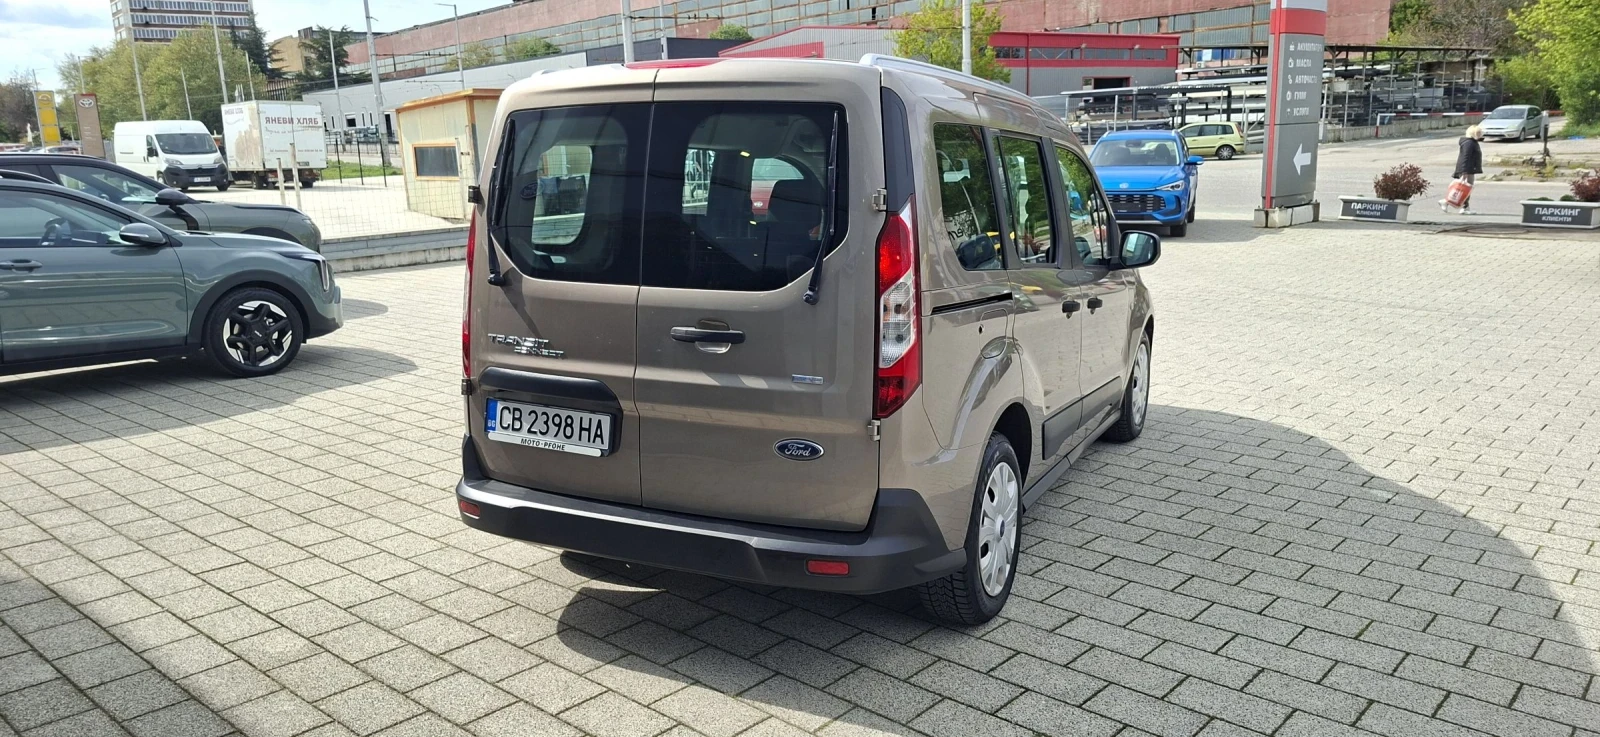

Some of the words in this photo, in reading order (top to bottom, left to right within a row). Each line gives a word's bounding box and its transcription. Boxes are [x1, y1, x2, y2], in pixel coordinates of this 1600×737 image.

[265, 117, 294, 125] ЯНЕВИ
[296, 117, 319, 125] ХЛЯБ
[1351, 202, 1388, 210] ПАРКИНГ
[1535, 208, 1580, 216] ПАРКИНГ
[488, 333, 549, 348] TRANSIT
[526, 410, 574, 440] 2398
[784, 443, 812, 456] Ford
